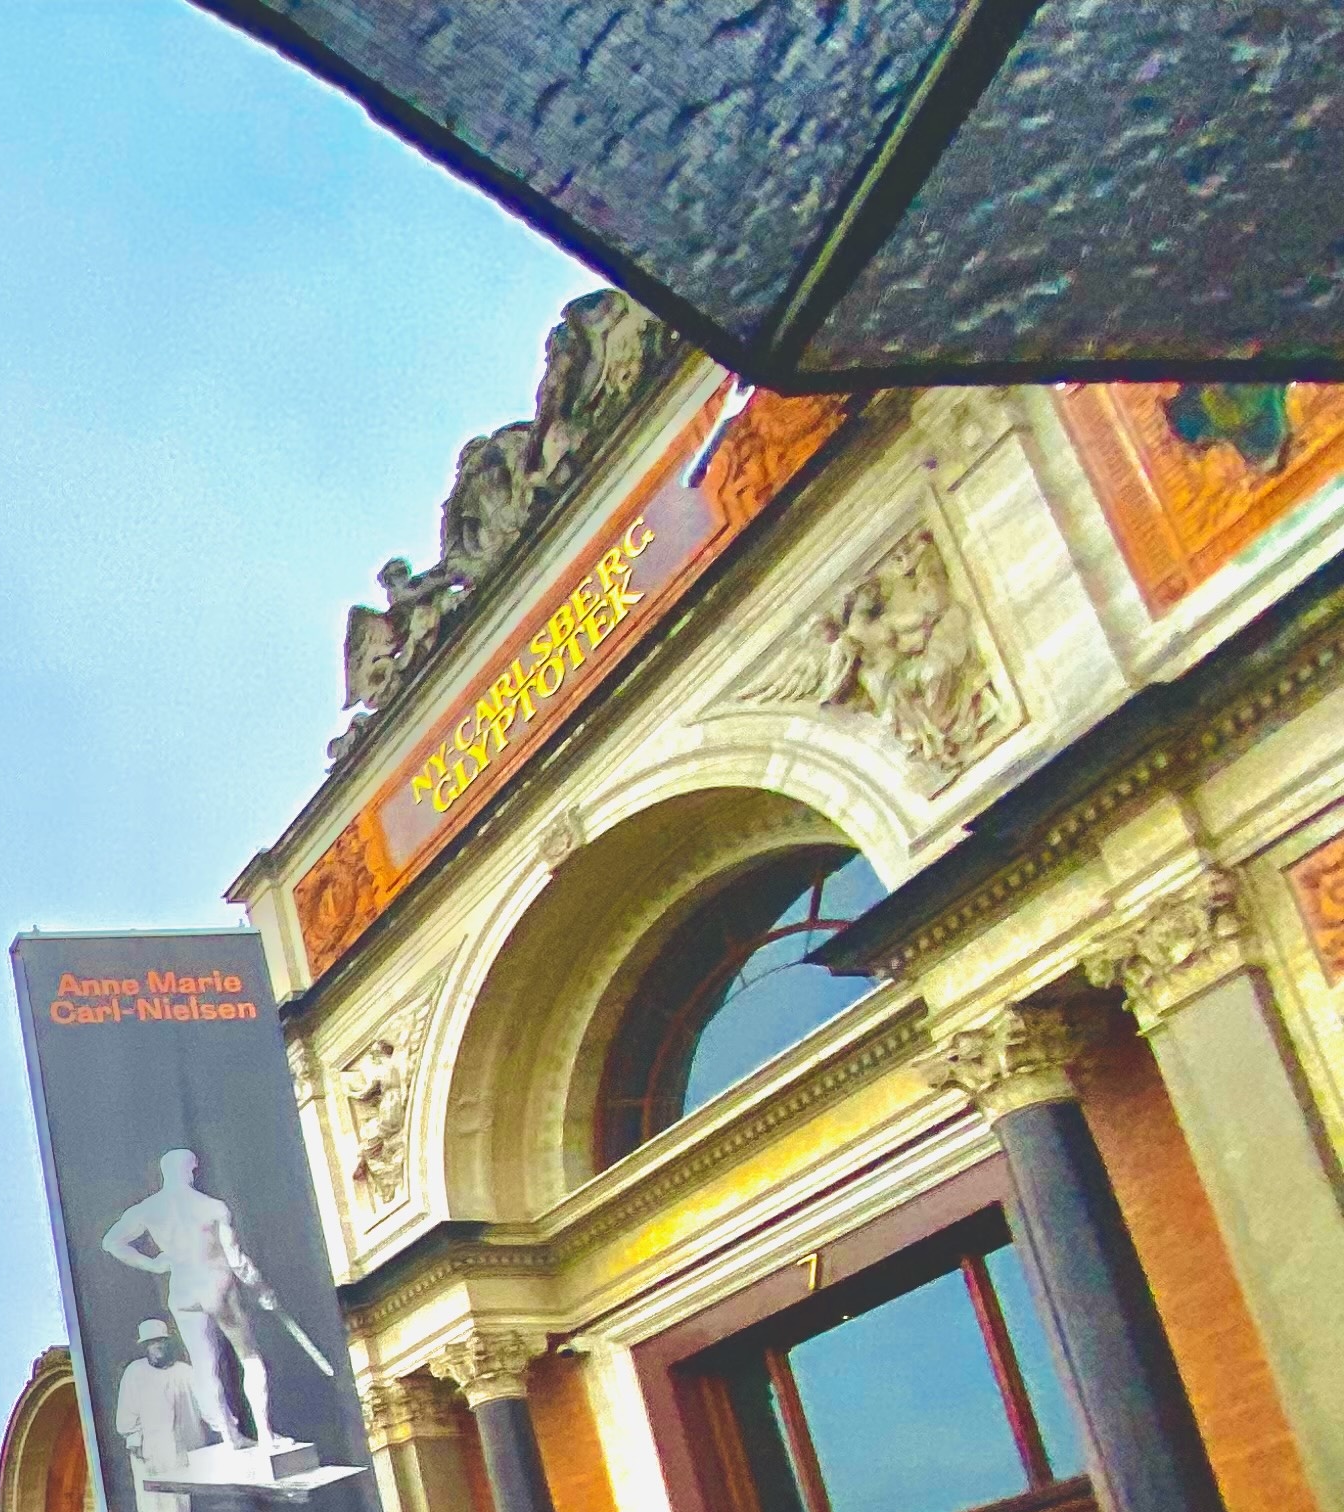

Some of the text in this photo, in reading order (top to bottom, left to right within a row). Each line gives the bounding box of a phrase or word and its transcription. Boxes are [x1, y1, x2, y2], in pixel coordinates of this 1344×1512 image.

[432, 568, 646, 813] GLYPTOTEK
[57, 969, 243, 997] Anne Marie
[49, 995, 257, 1025] Carl-Nielsen
[796, 1253, 817, 1291] 7
